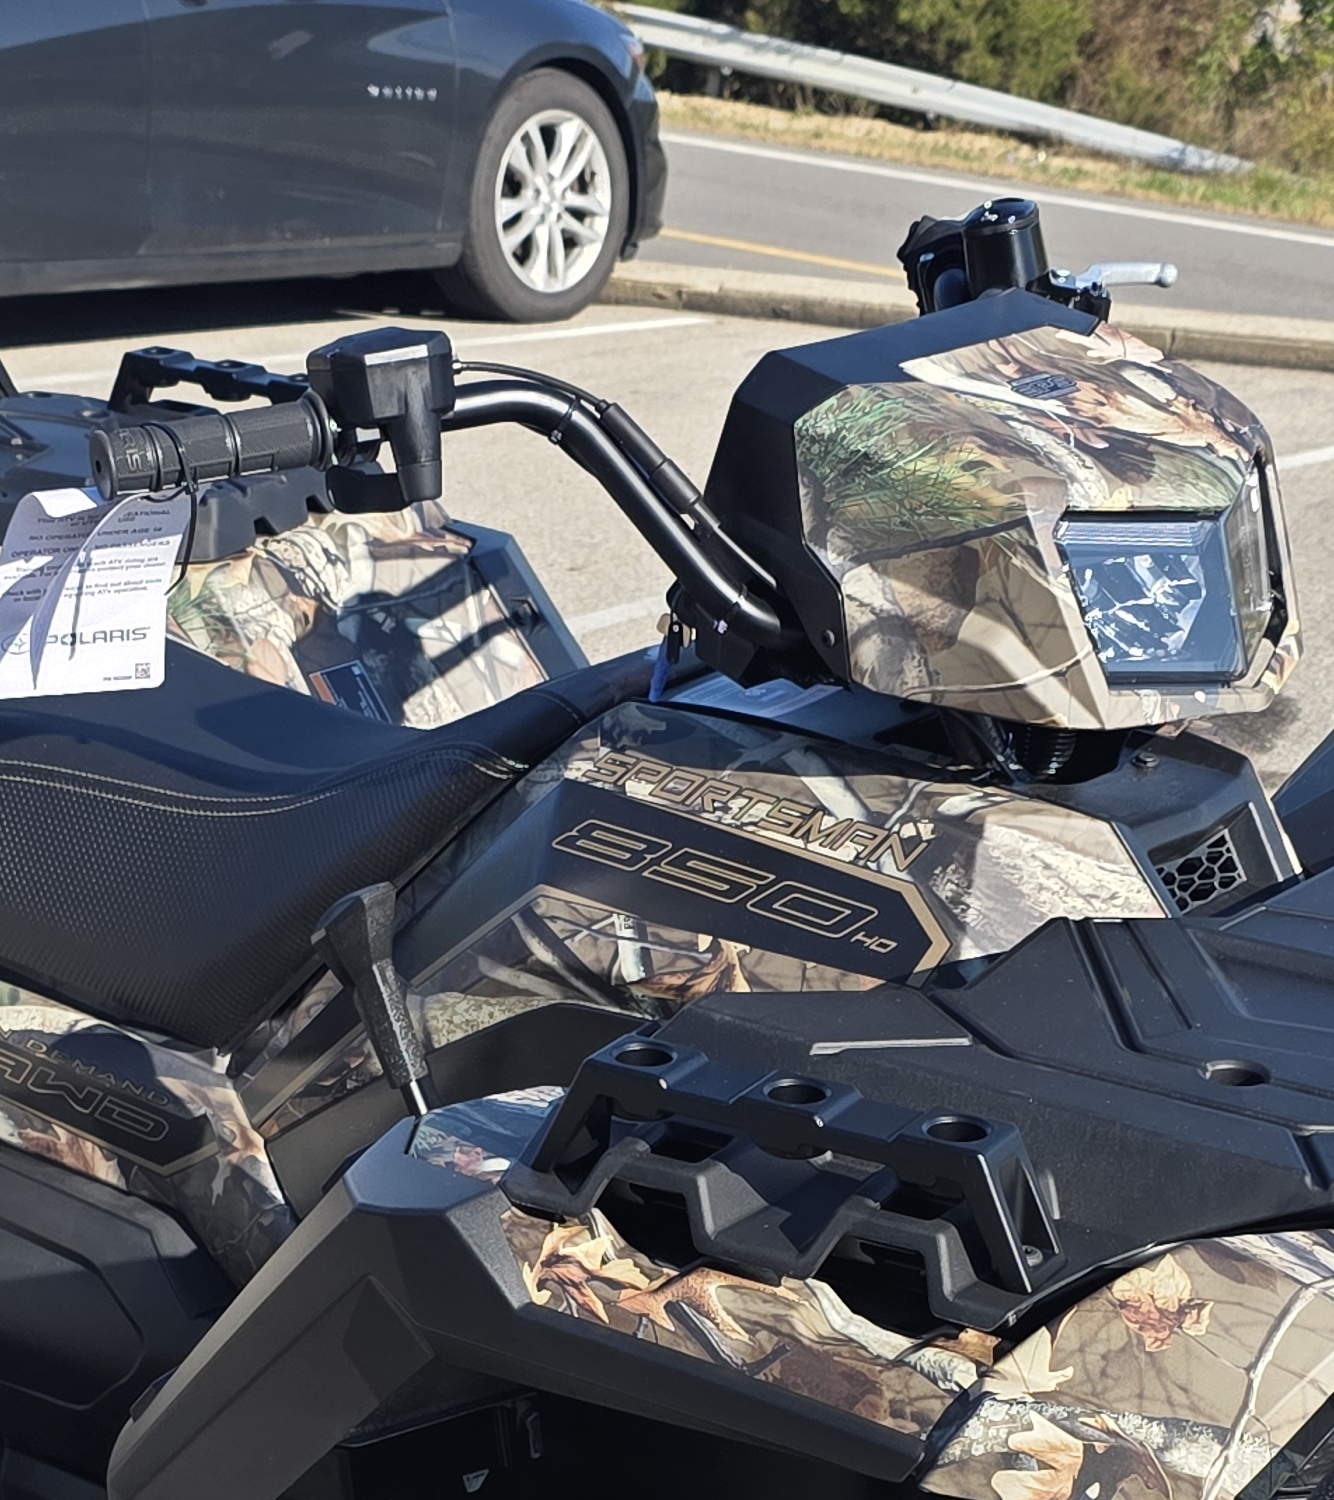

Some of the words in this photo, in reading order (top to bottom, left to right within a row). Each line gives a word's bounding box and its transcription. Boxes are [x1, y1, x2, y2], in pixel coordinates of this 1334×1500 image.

[586, 752, 929, 872] SPORTSMAN
[552, 819, 879, 938] 850
[26, 1038, 172, 1106] DEMAND
